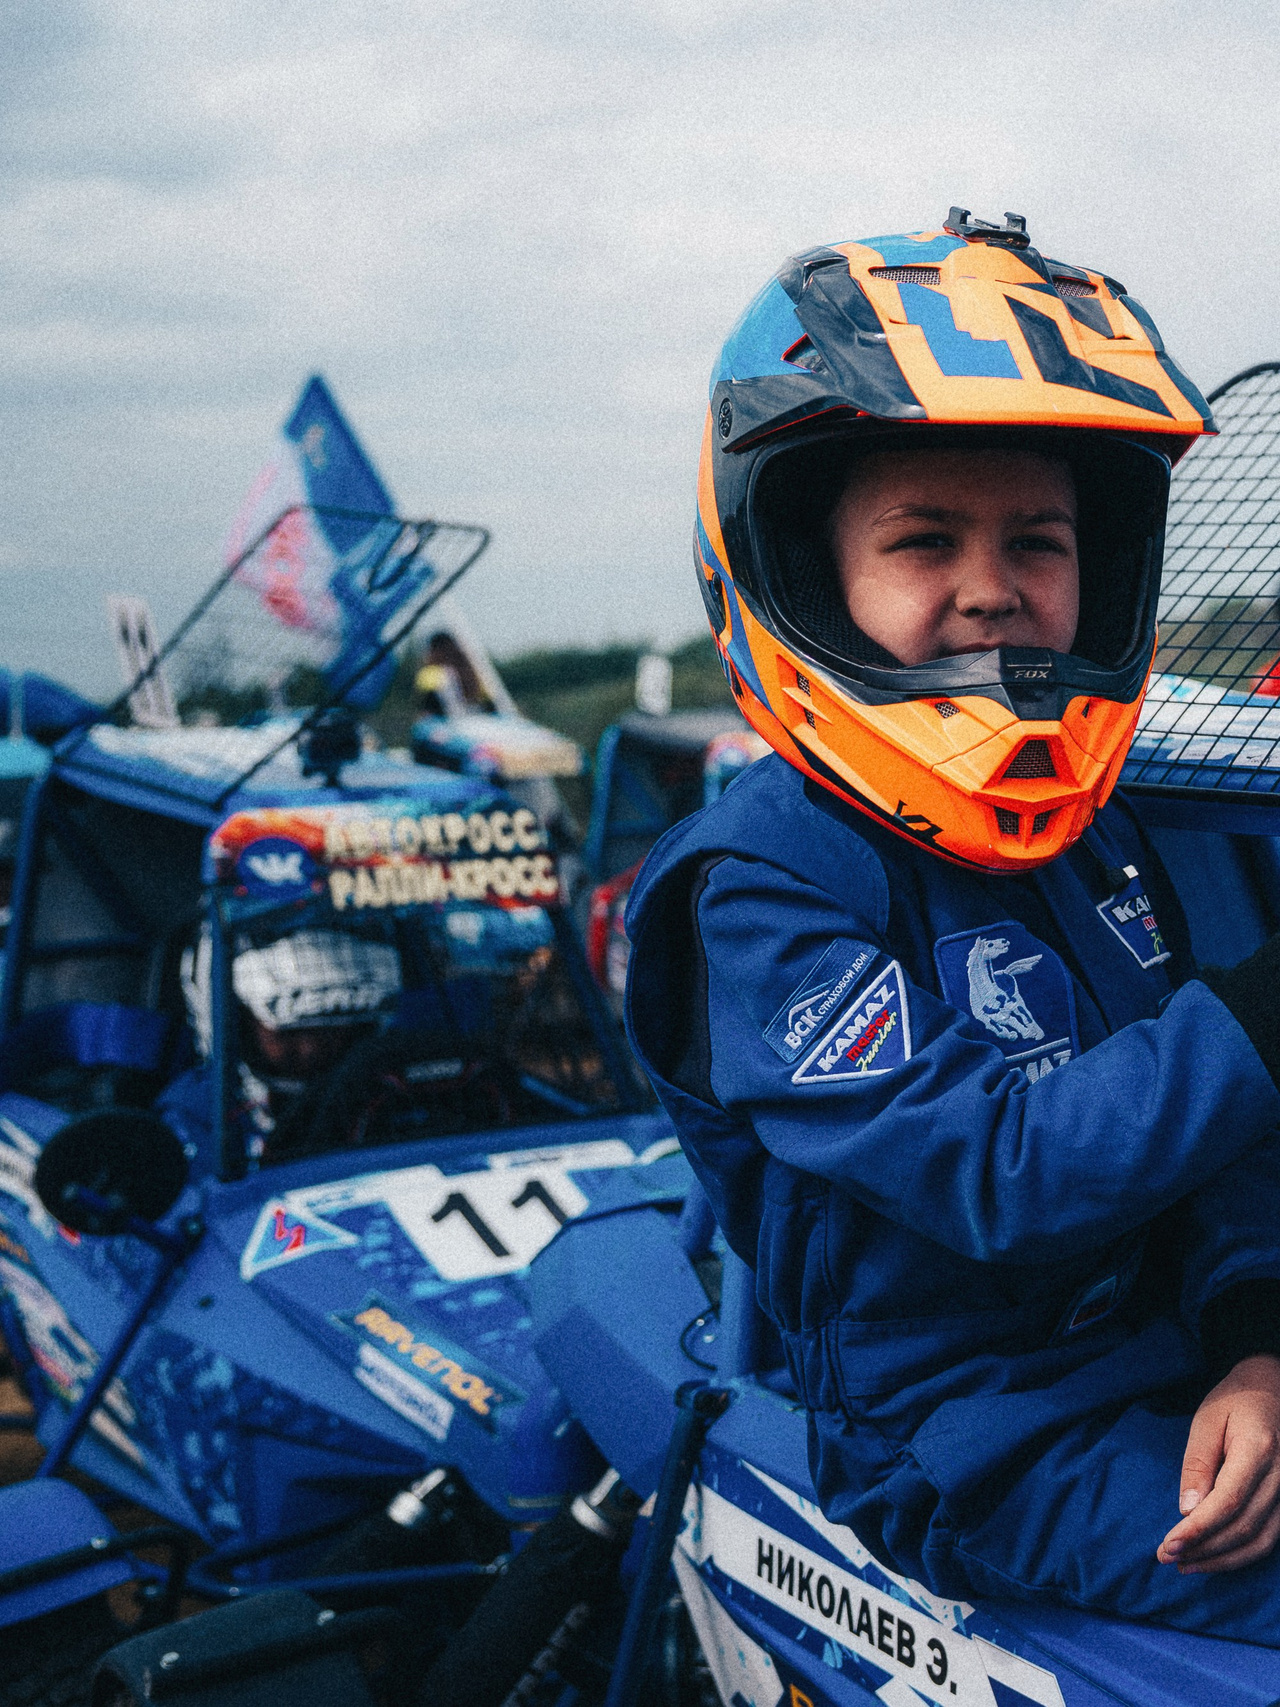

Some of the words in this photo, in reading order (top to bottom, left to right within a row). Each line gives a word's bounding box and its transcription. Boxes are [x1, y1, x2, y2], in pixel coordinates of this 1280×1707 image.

[1014, 669, 1050, 679] FOX
[817, 968, 856, 1015] СТРАХОВОЙ
[851, 952, 869, 973] ДОМ
[783, 1007, 824, 1050] ВСК
[817, 984, 896, 1073] KAMAZ
[846, 1009, 891, 1062] master
[855, 1011, 897, 1072] Junior
[431, 1181, 568, 1257] 11
[757, 1537, 916, 1669] НИКОЛАЕВ
[926, 1637, 957, 1695] Э.
